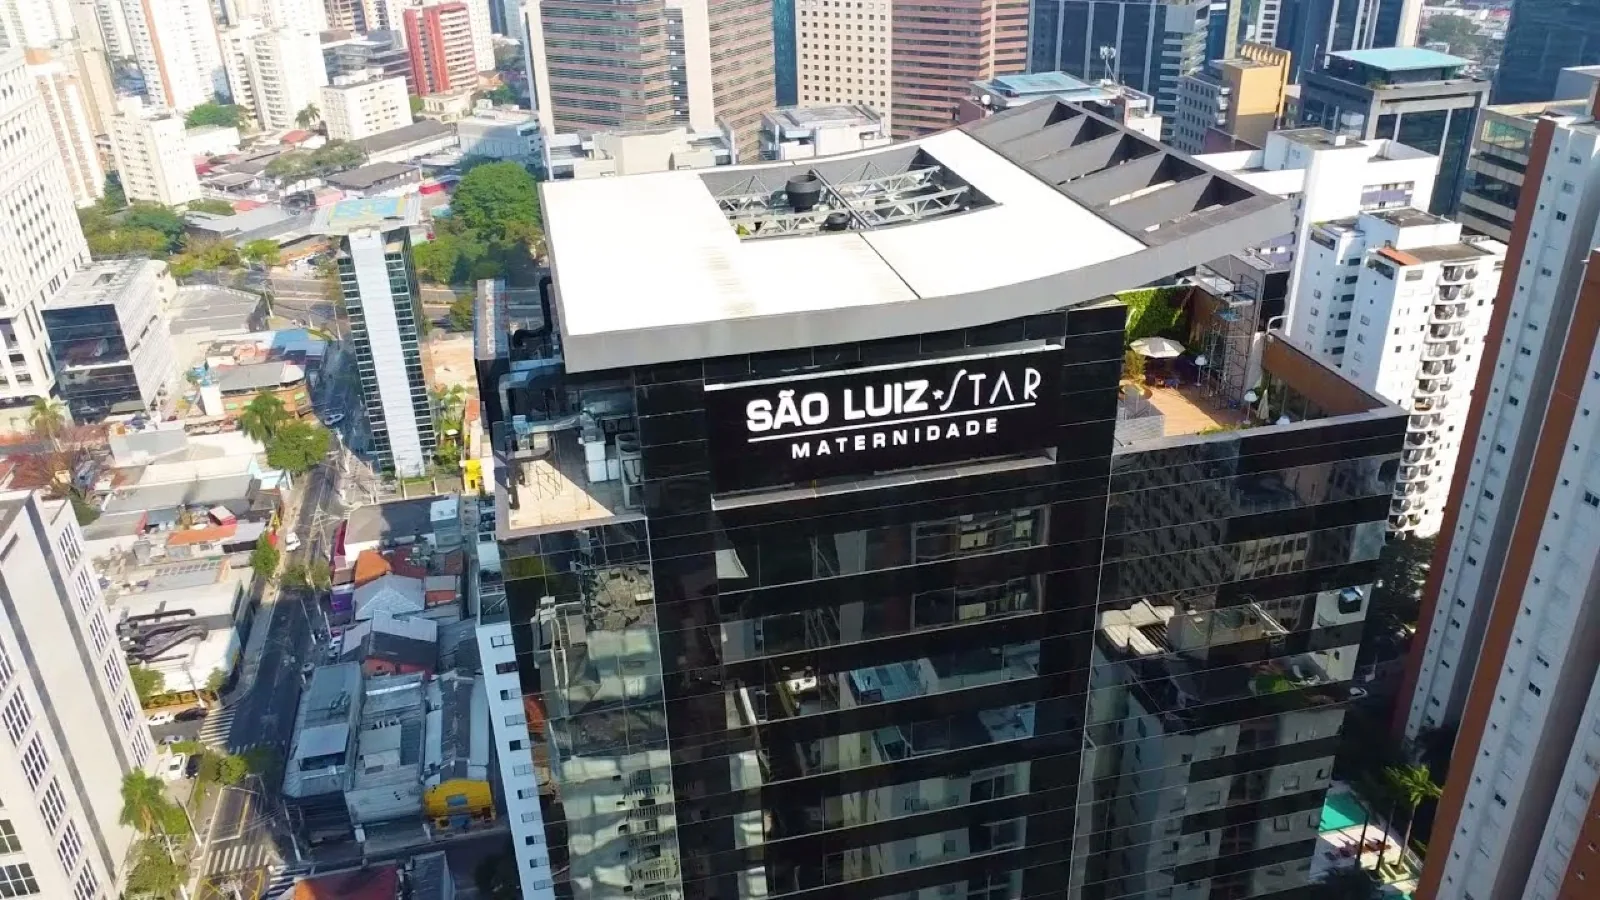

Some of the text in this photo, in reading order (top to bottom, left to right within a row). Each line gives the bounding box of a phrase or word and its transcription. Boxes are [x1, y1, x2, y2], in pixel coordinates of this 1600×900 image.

[746, 367, 1041, 432] SÃO LUIZ STAR
[791, 417, 998, 459] MATERNIDADE
